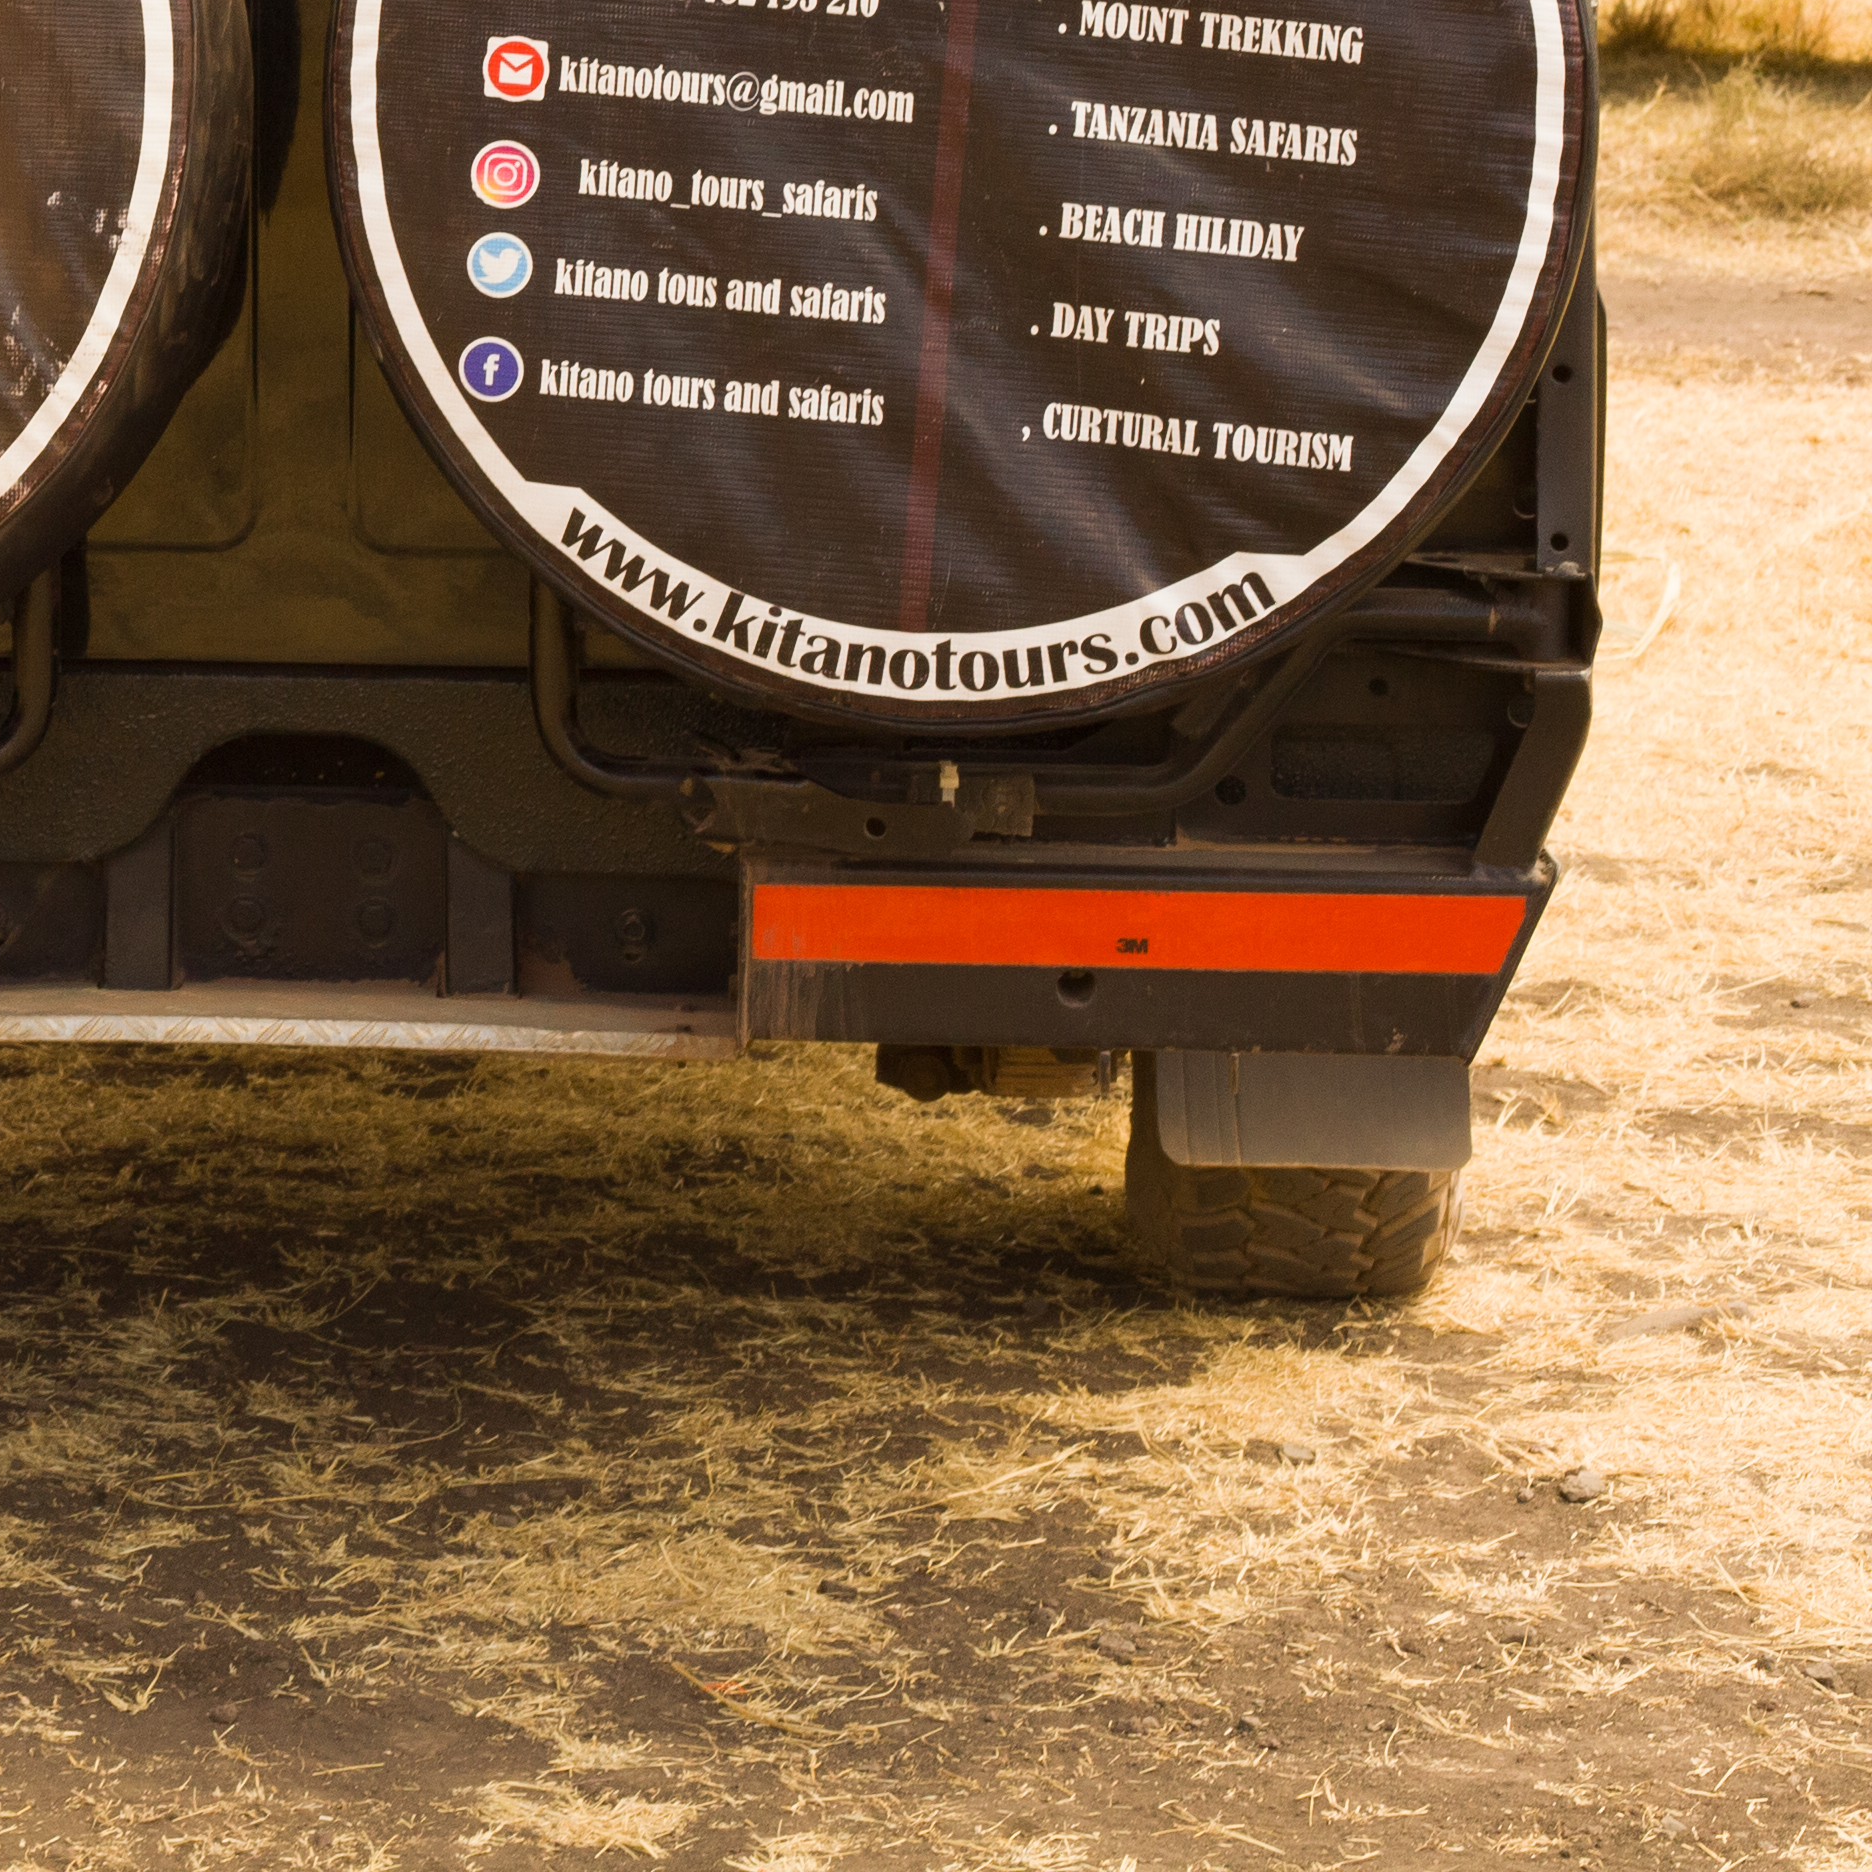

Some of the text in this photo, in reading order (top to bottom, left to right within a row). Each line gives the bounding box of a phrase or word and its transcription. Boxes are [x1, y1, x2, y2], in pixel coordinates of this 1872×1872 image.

[1079, 0, 1364, 65] MOUNT TREKKING
[558, 55, 914, 123] kitanotours@gmail.com
[1071, 101, 1358, 167] TANZANIA SAFARIS
[578, 159, 878, 222] kitano_tours_safaris
[1059, 202, 1305, 262] BEACH HILIDAY
[554, 259, 887, 325] kitano tous and safaris
[1050, 302, 1221, 357] DAY TRIPS
[539, 359, 884, 426] kitano tours and safaris
[1043, 402, 1354, 473] CURTURAL TOURISM
[559, 505, 1277, 692] www.kitanotours.com
[1116, 938, 1149, 954] 3M
